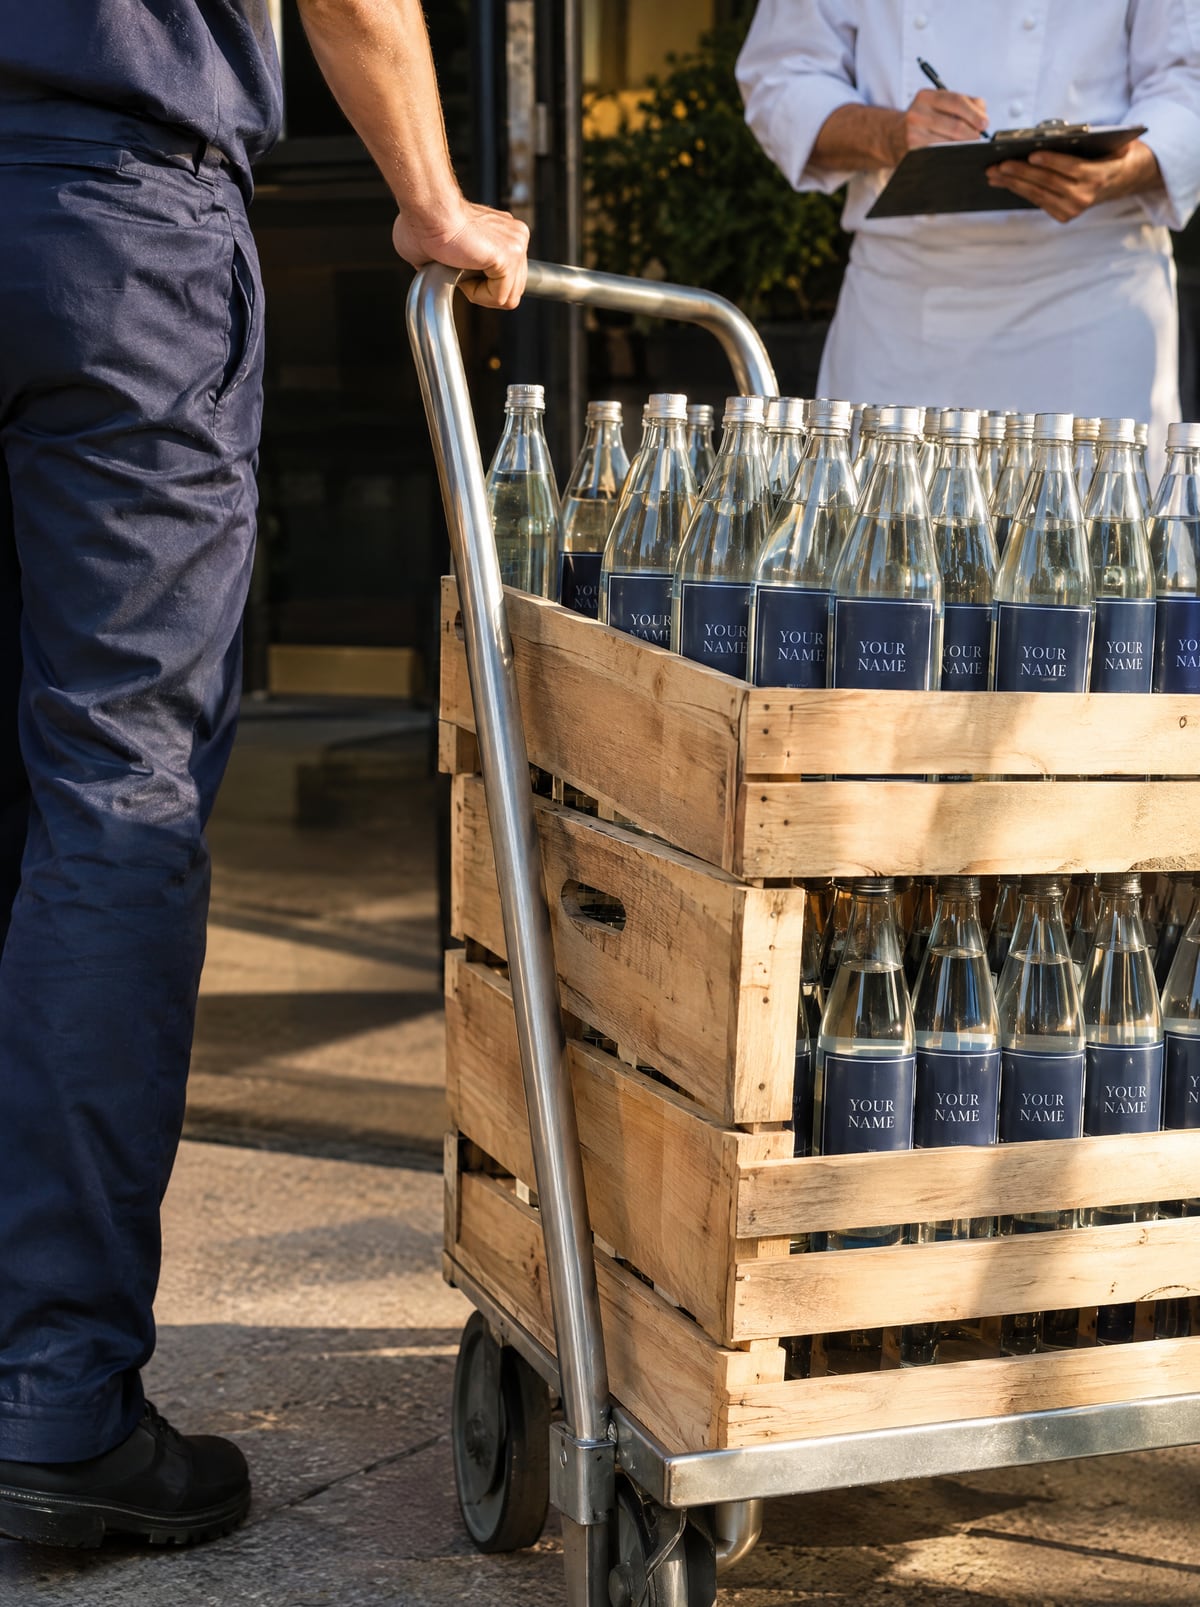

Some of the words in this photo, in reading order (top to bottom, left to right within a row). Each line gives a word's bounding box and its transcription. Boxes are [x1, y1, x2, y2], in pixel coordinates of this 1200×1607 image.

[630, 613, 671, 626] YOUR
[704, 623, 747, 638] YOUR
[779, 630, 824, 645] YOUR
[703, 640, 748, 654] NAME
[859, 640, 906, 656] YOUR
[1106, 641, 1143, 654] YOUR
[1178, 639, 1200, 651] YO
[778, 647, 825, 661] NAME
[1022, 646, 1066, 661] YOUR
[858, 658, 906, 673] NAME
[1104, 658, 1143, 670] NAME
[1176, 655, 1200, 668] NA
[1020, 663, 1067, 677] NAME
[936, 1092, 980, 1106] YOUR
[1105, 1085, 1147, 1099] YOUR
[849, 1098, 895, 1113] YOUR
[1022, 1093, 1064, 1106] YOUR
[1104, 1101, 1147, 1114] NAME
[848, 1115, 895, 1129] NAME
[934, 1109, 980, 1122] NAME
[1020, 1109, 1065, 1122] NAME
